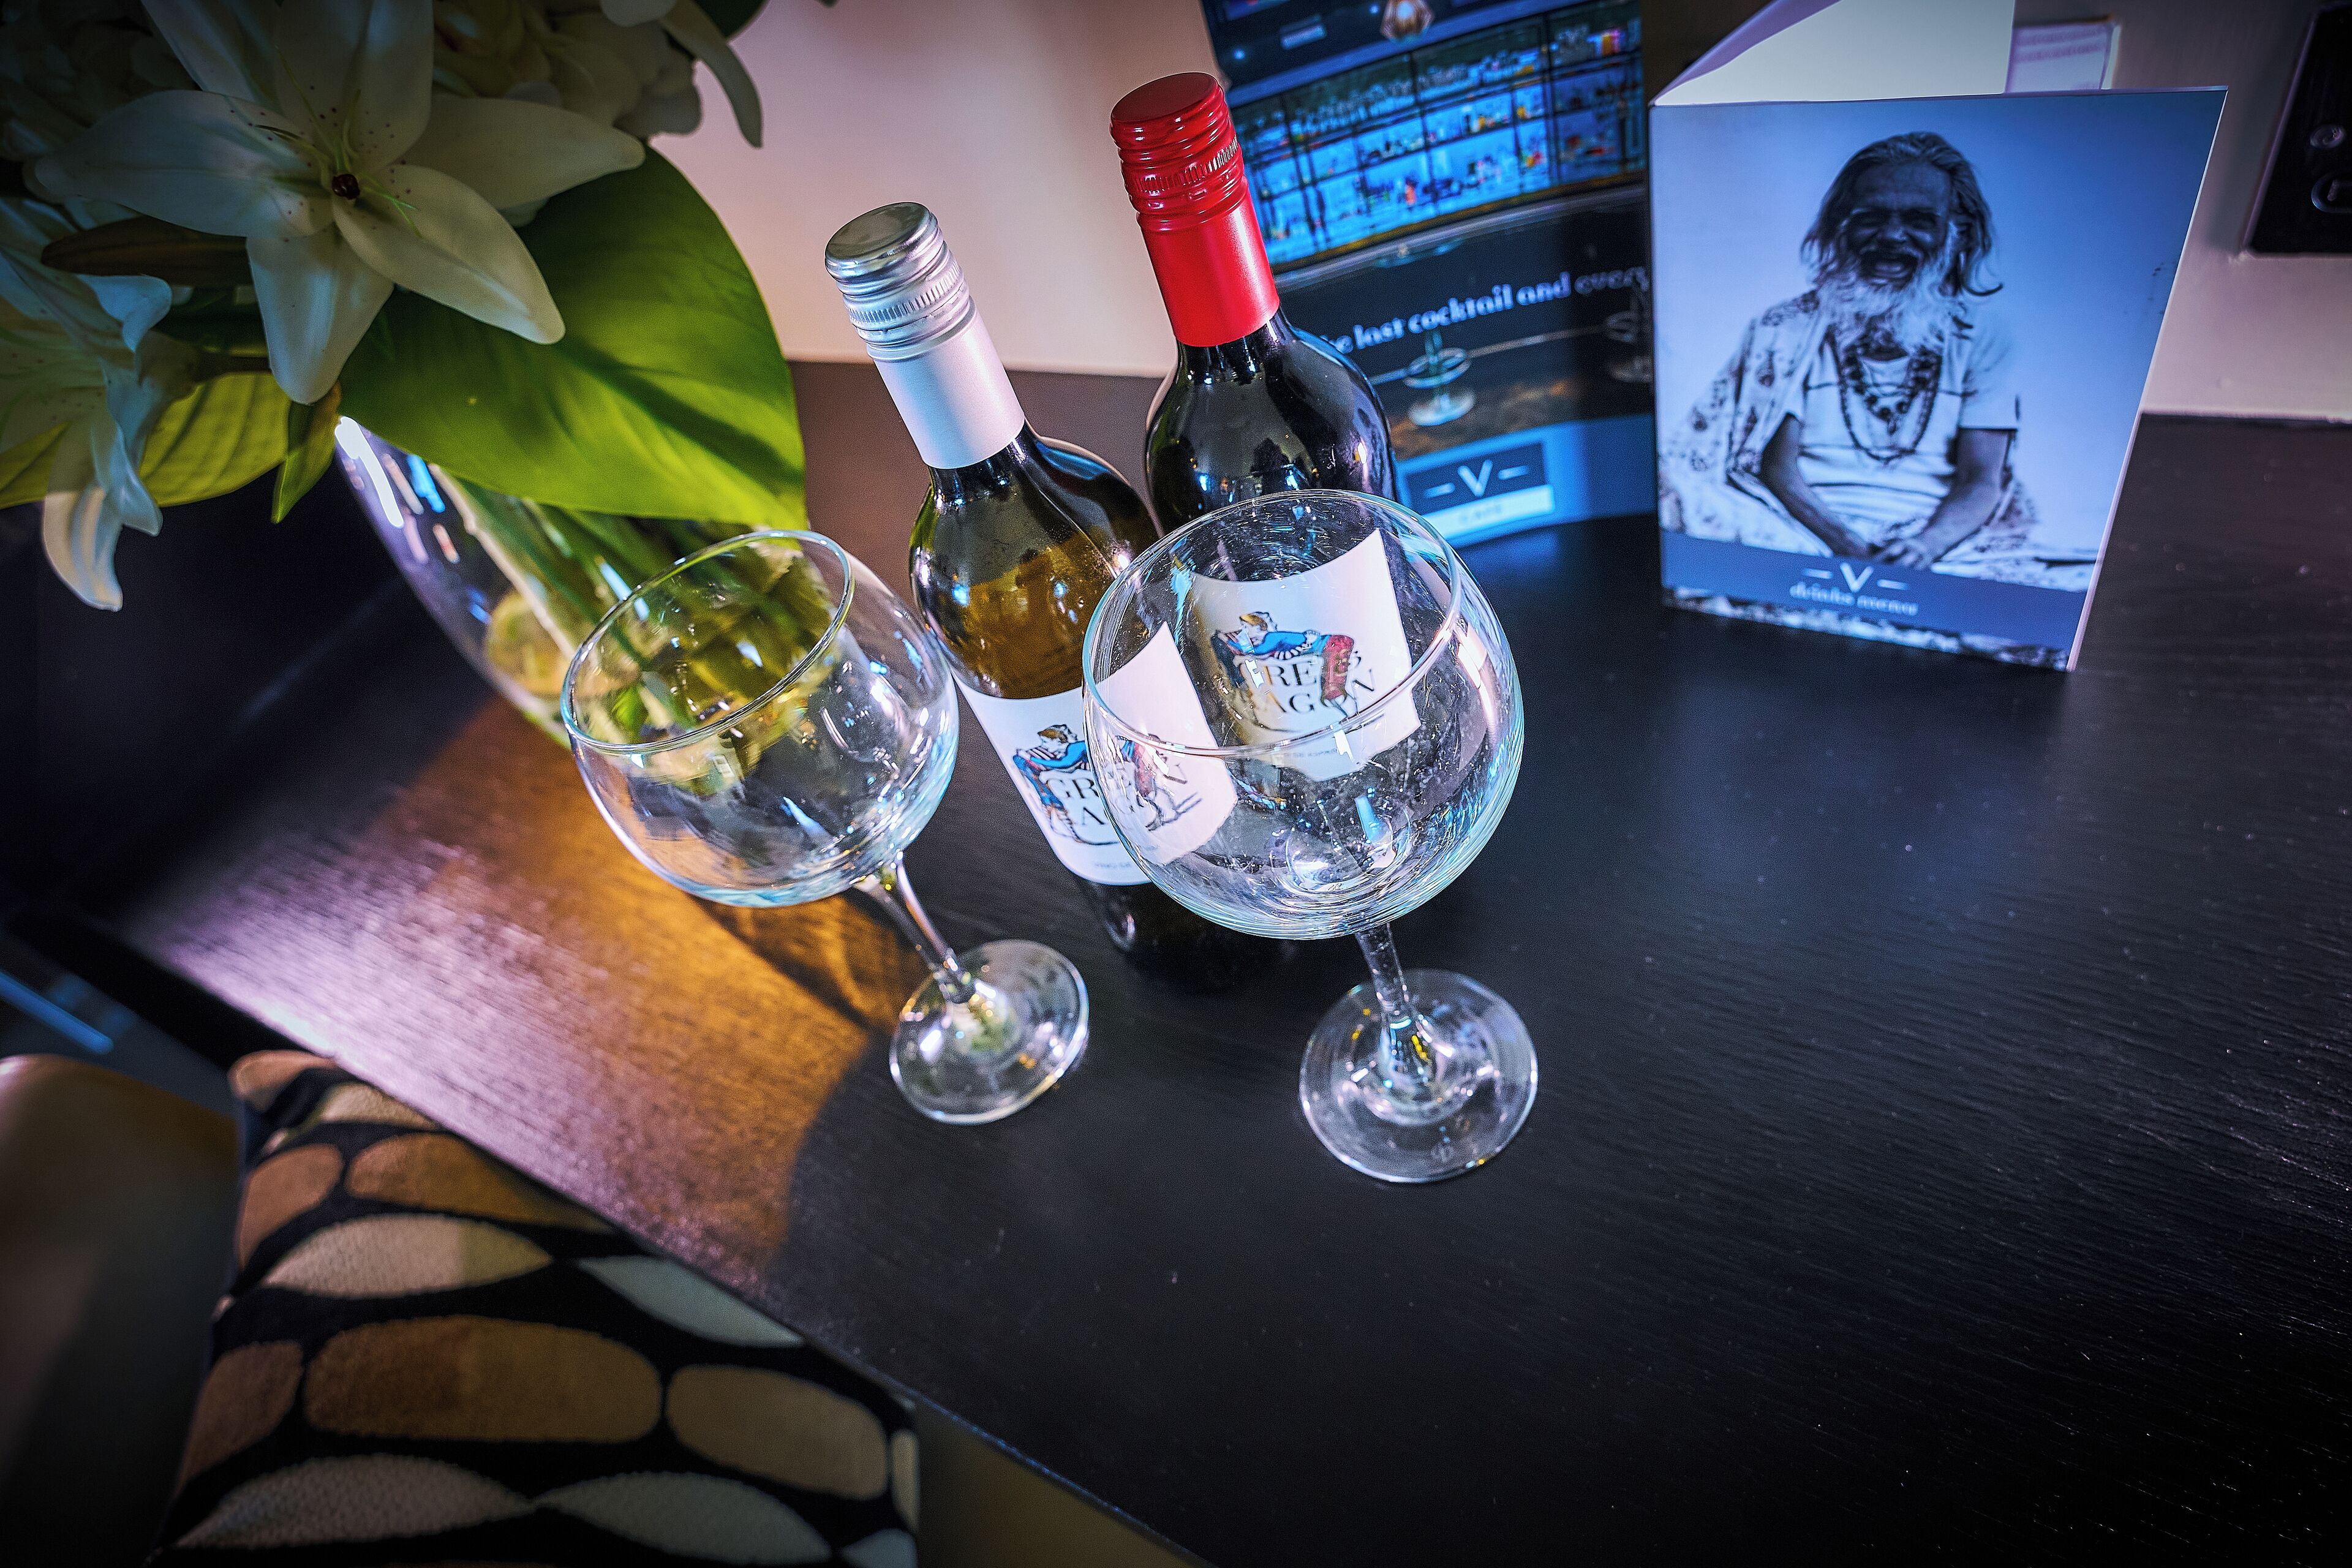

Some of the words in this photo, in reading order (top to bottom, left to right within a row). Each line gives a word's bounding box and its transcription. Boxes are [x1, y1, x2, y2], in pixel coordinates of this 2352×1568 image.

[1352, 317, 1406, 350] last
[1408, 284, 1513, 334] cocktail
[1516, 271, 1572, 306] and
